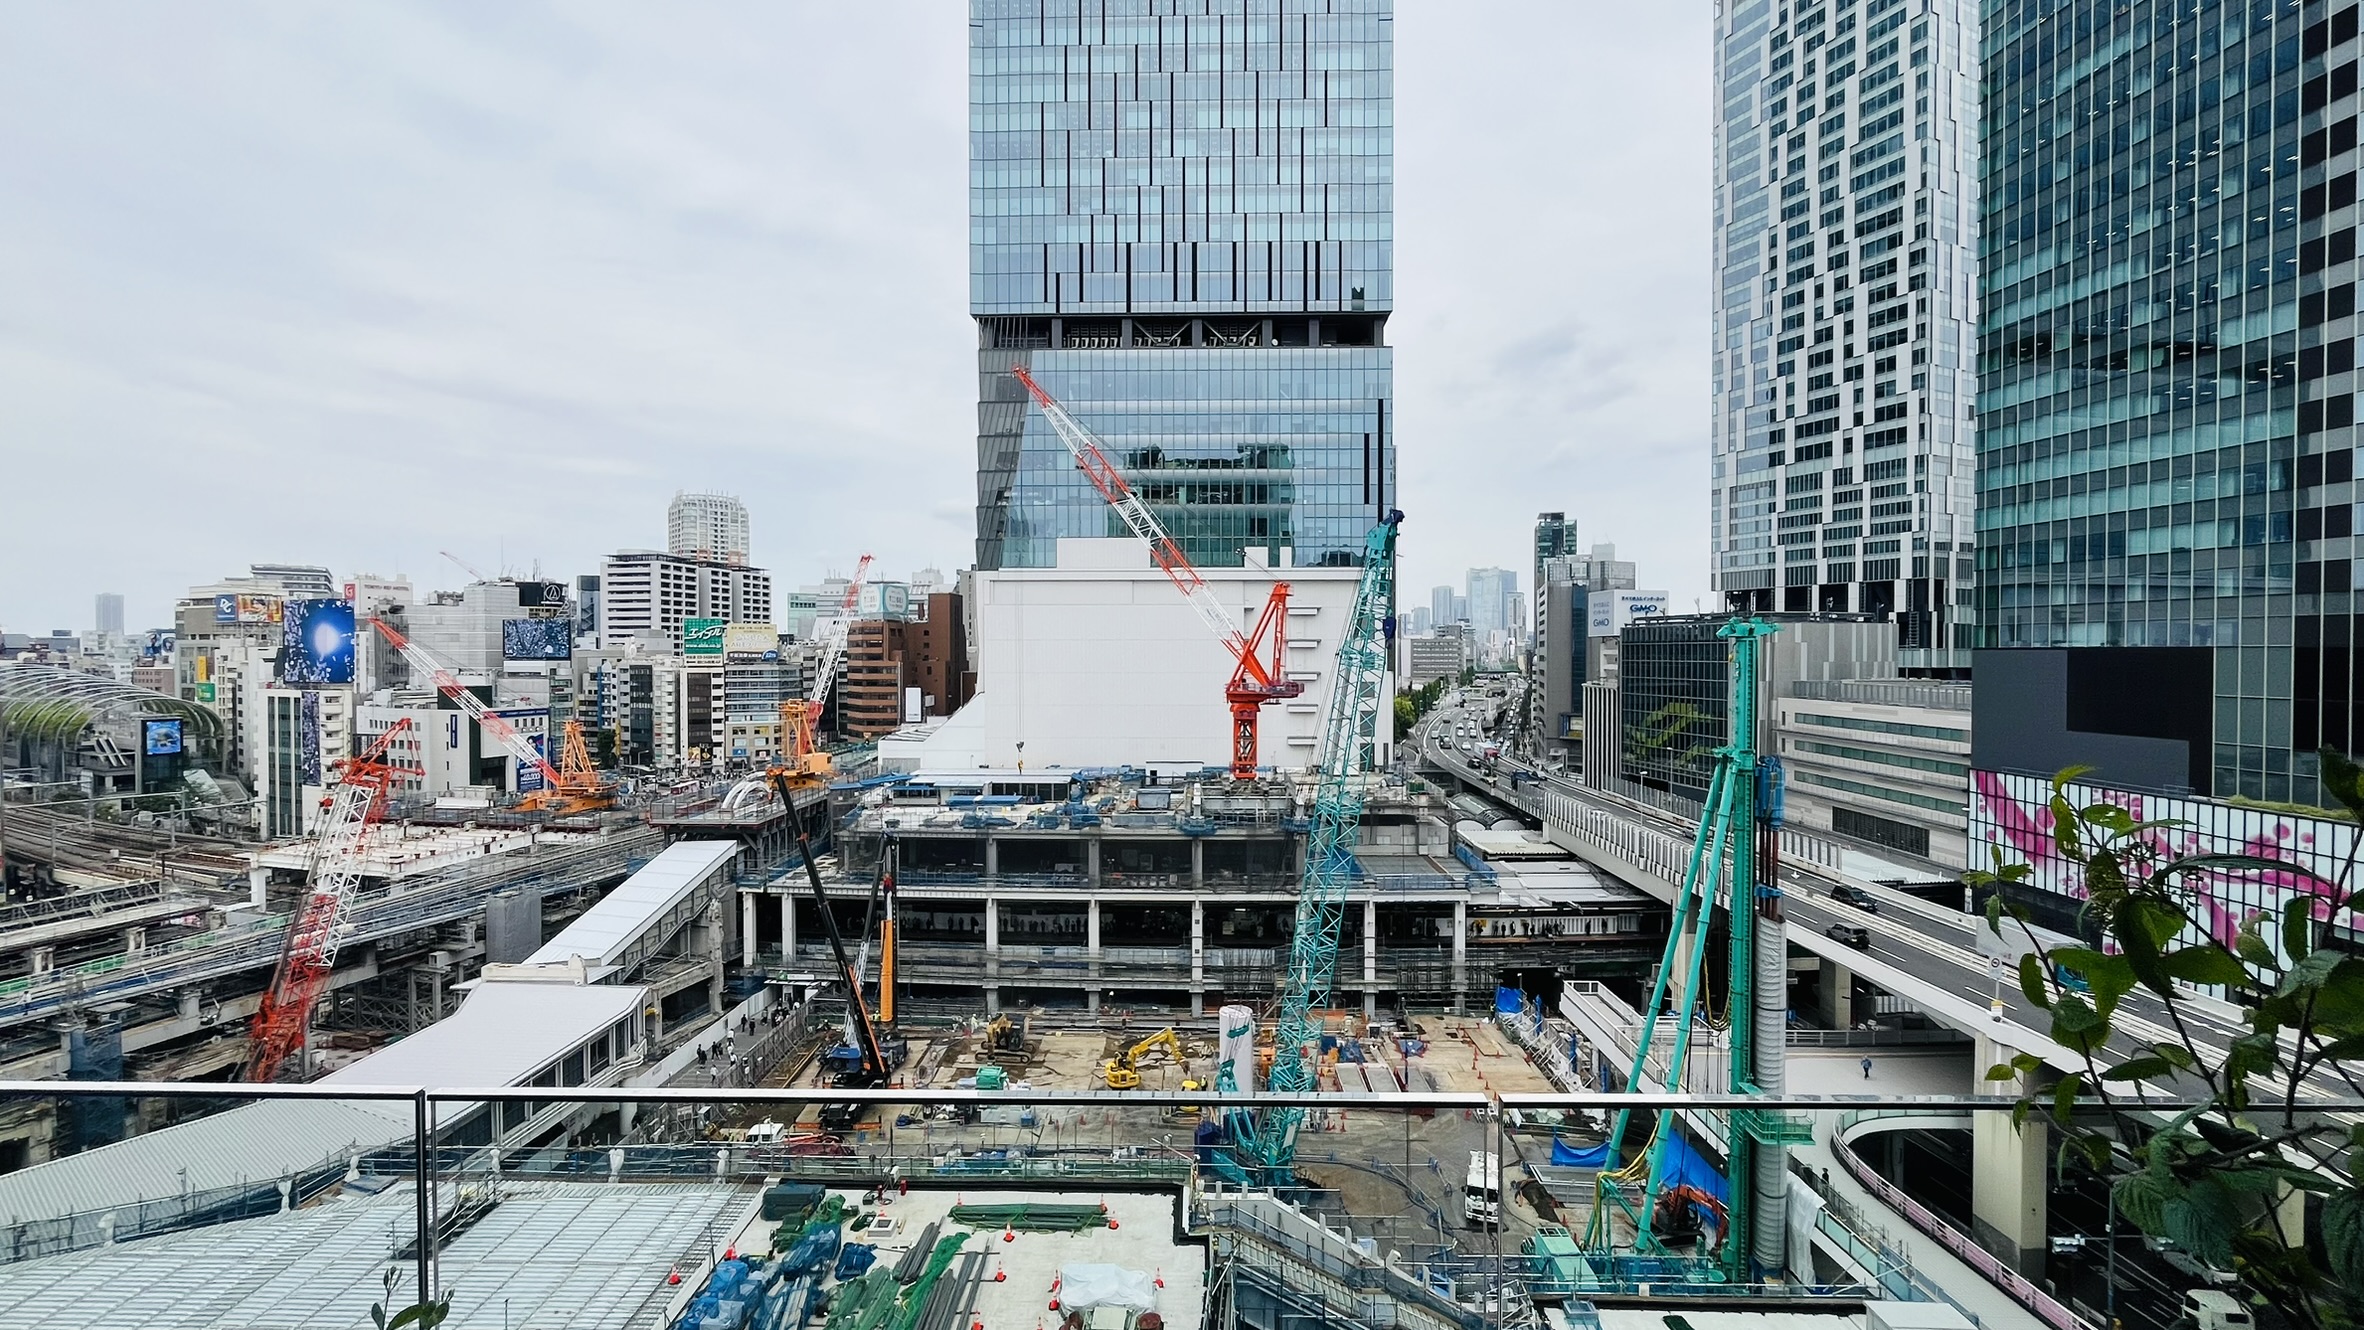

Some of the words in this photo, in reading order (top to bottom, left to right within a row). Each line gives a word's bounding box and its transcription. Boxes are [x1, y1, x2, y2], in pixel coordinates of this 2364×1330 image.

[1630, 604, 1657, 612] GMO
[1593, 618, 1609, 627] GMO
[686, 626, 722, 640] エイブル
